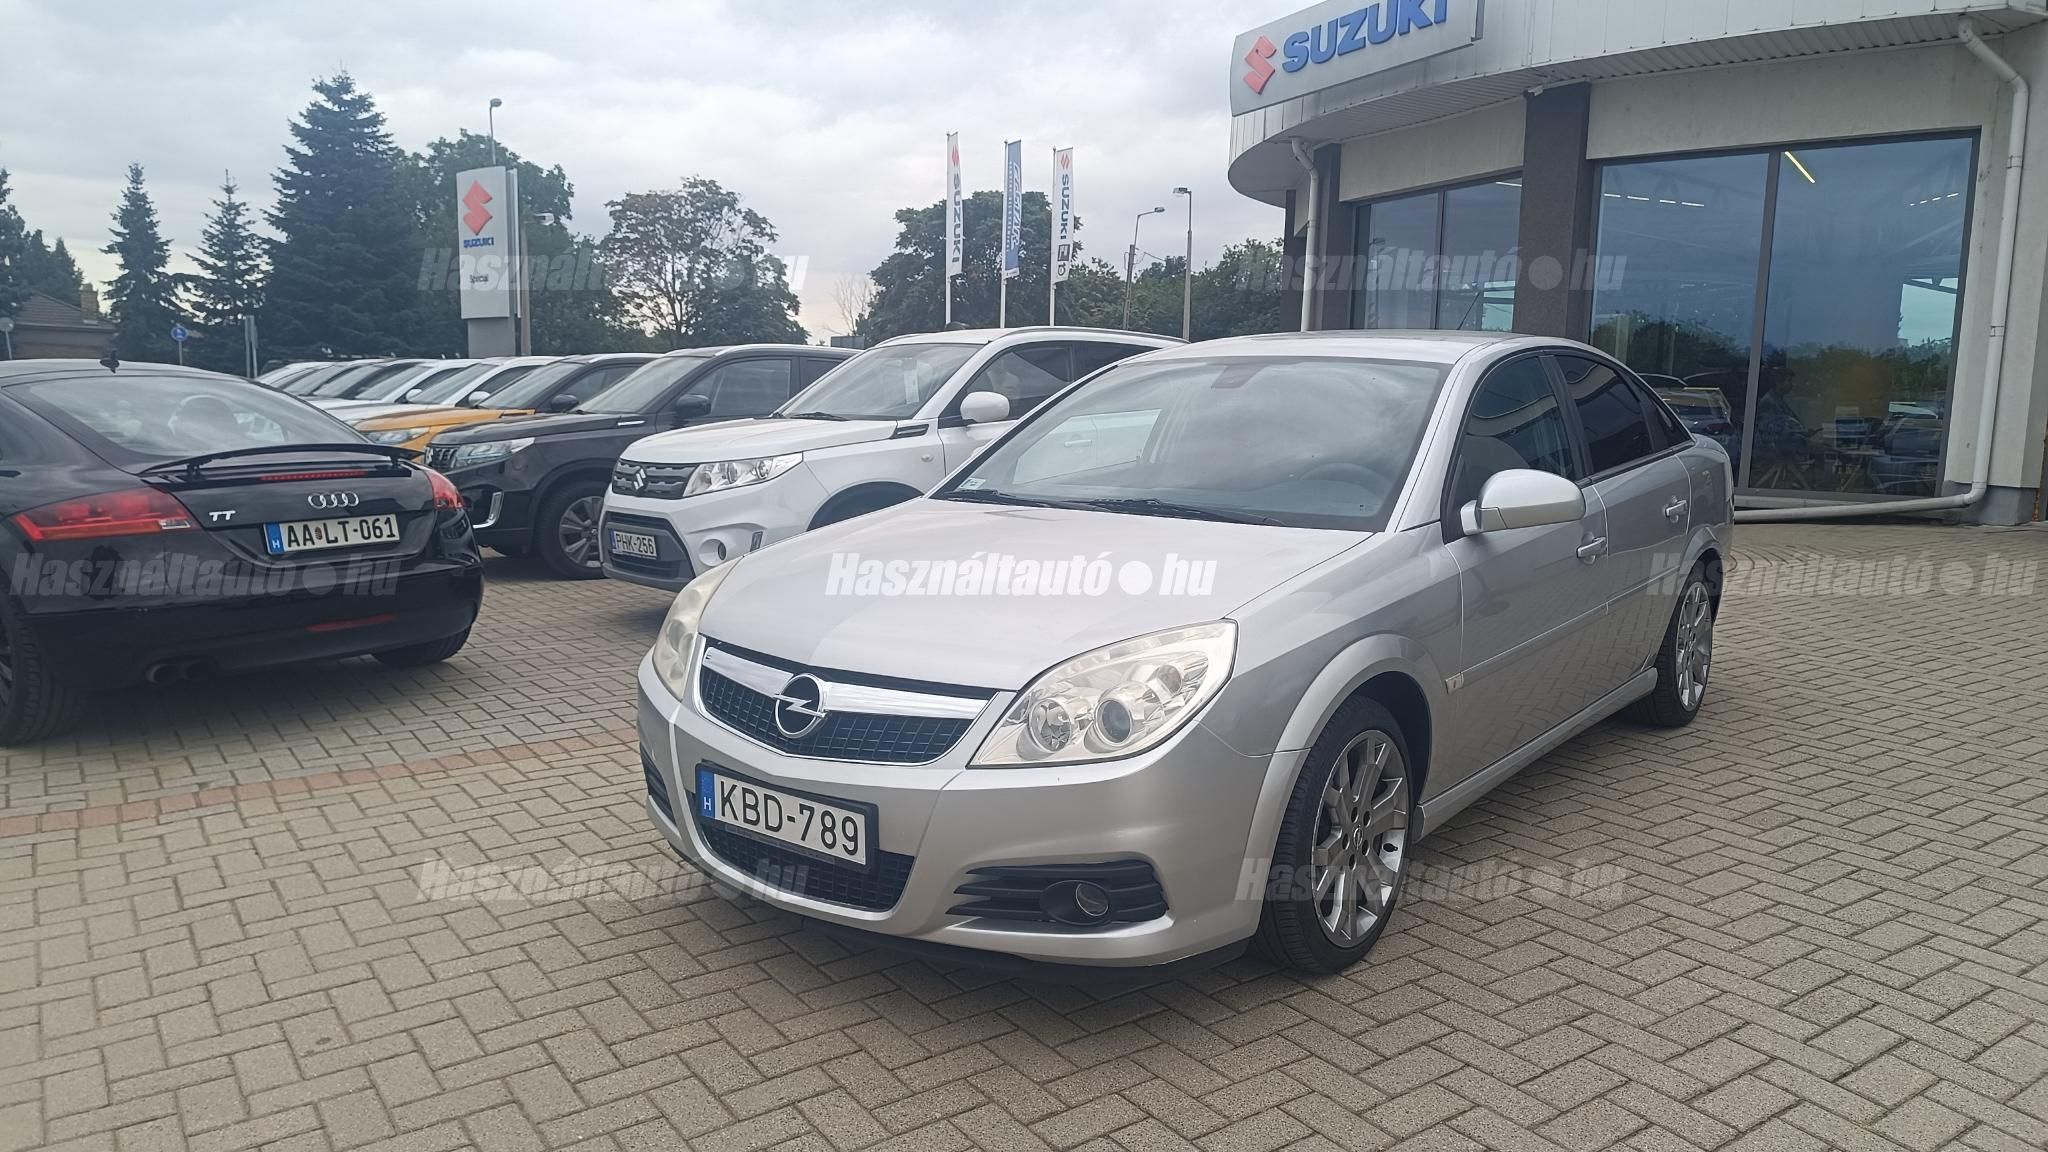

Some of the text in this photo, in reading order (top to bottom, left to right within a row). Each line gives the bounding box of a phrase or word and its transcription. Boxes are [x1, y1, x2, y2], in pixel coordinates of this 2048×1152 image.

[1282, 0, 1447, 73] SUZUKI
[952, 173, 962, 262] SUZUKI
[1060, 174, 1070, 239] SUZUKI
[463, 237, 494, 248] SUZUKI
[209, 510, 236, 521] TT
[272, 539, 281, 548] H
[616, 533, 655, 555] PHK-256
[703, 797, 712, 811] H
[720, 780, 858, 856] KBD-789
